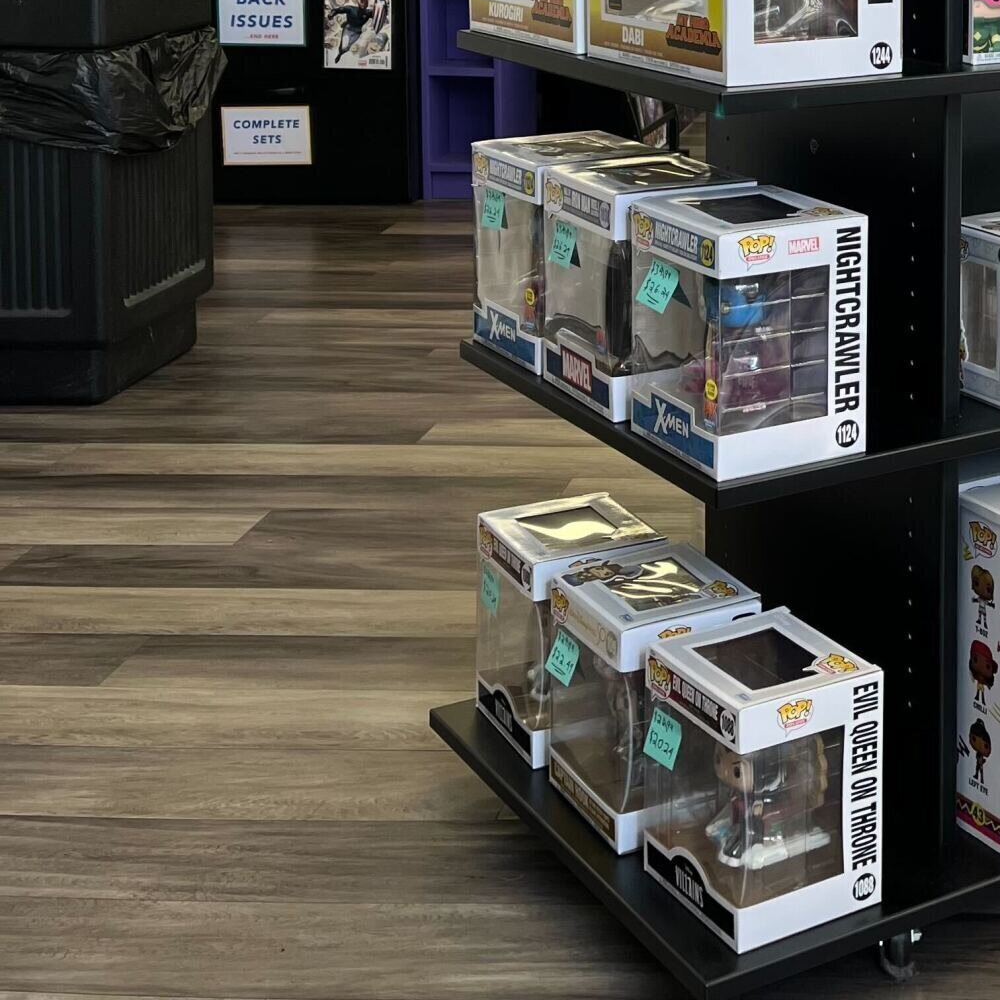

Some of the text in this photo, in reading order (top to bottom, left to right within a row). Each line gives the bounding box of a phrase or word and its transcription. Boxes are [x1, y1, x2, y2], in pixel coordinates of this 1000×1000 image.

[230, 14, 294, 29] ISSUES
[488, 1, 524, 23] KUROGIRI
[532, 0, 571, 24] ACADEMIA
[621, 25, 644, 47] DABI
[666, 24, 721, 49] ACADEMIA
[871, 46, 891, 65] 1244
[233, 119, 300, 129] COMPLETE
[252, 134, 282, 144] SETS
[489, 159, 522, 185] NIGHTCRAWLER
[654, 223, 699, 250] NIGHTCRAWLER
[737, 233, 777, 257] POP!
[788, 237, 820, 255] MARVEL
[835, 226, 862, 415] NIGHTCRAWLER
[561, 349, 593, 392] MARVEL
[837, 424, 859, 444] 1124
[777, 699, 813, 721] POP!
[850, 680, 879, 872] EVIL QUEEN ON THRONE
[968, 777, 980, 788] LEFT
[972, 804, 984, 822] 43
[854, 876, 876, 896] 1088
